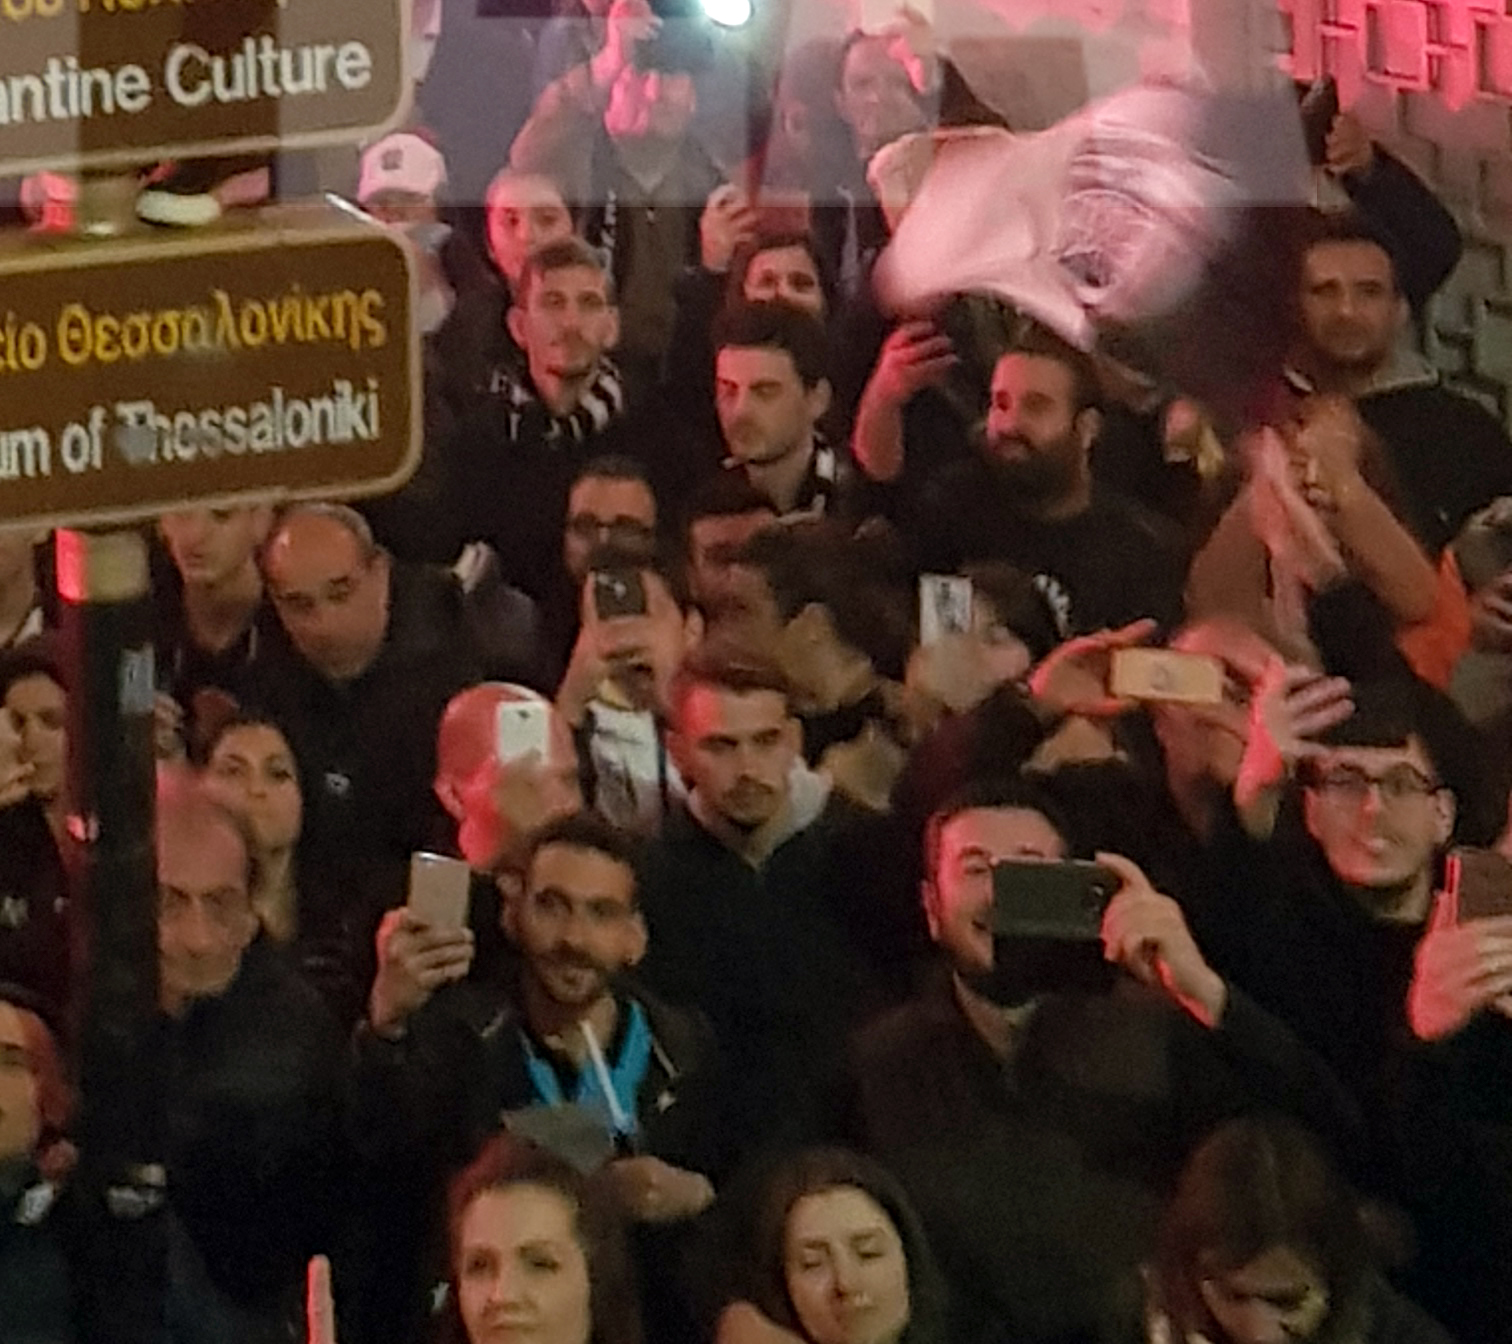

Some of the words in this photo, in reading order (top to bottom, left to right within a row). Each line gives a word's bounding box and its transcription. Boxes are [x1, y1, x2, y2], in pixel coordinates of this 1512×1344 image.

[164, 33, 373, 108] Culture
[56, 282, 386, 366] Θεσσαλονίκης
[61, 405, 108, 473] of
